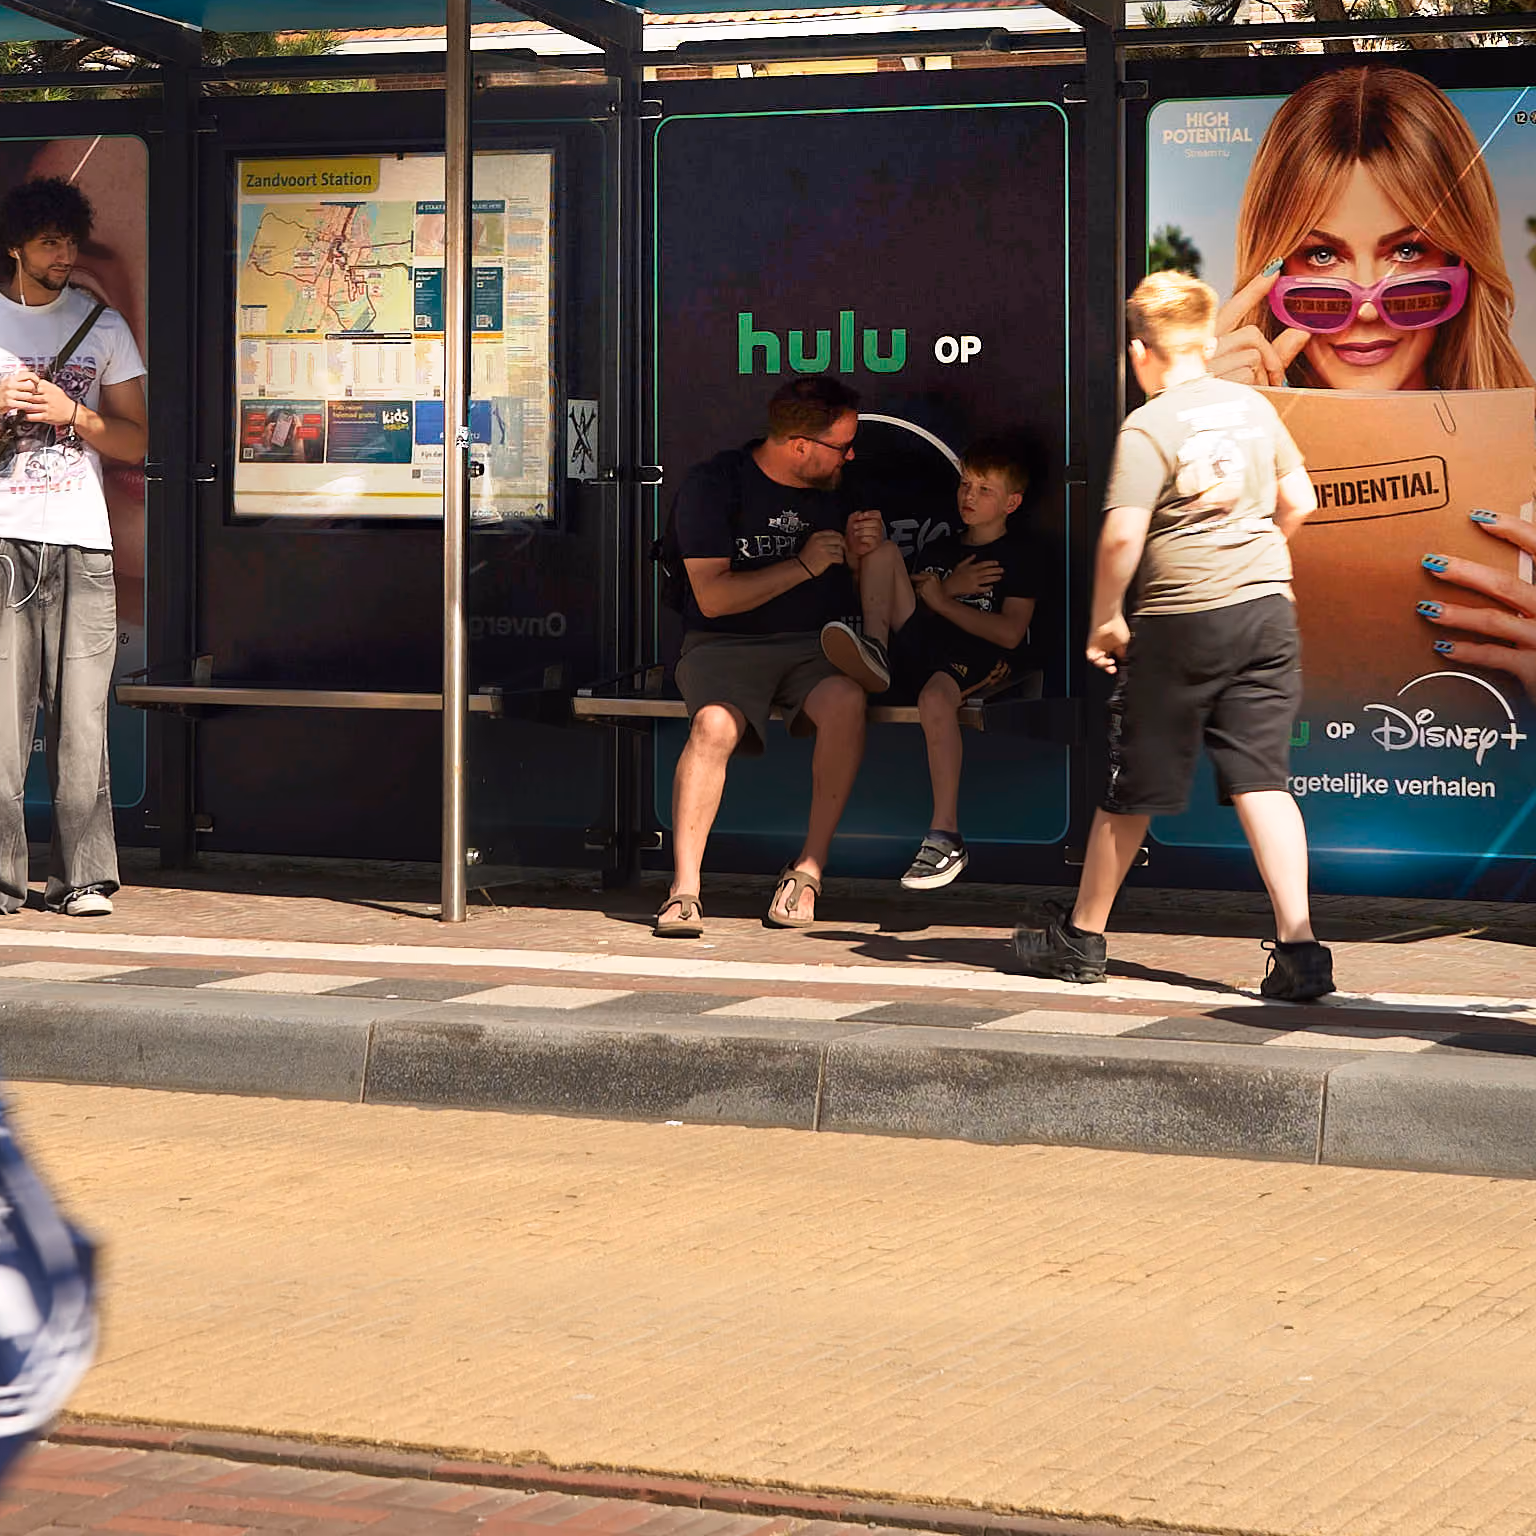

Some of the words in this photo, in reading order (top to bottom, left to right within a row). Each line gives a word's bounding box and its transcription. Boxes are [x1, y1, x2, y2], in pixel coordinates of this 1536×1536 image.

[1186, 112, 1229, 127] HIGH
[1163, 128, 1253, 144] POTENTIAL
[246, 174, 317, 187] Zandvoort
[321, 173, 372, 187] Station
[738, 311, 907, 374] hulu
[934, 335, 982, 364] OP
[383, 410, 409, 424] kids
[1326, 723, 1355, 739] OP
[1287, 772, 1389, 798] rgetelijke
[1394, 775, 1496, 797] verhalen
